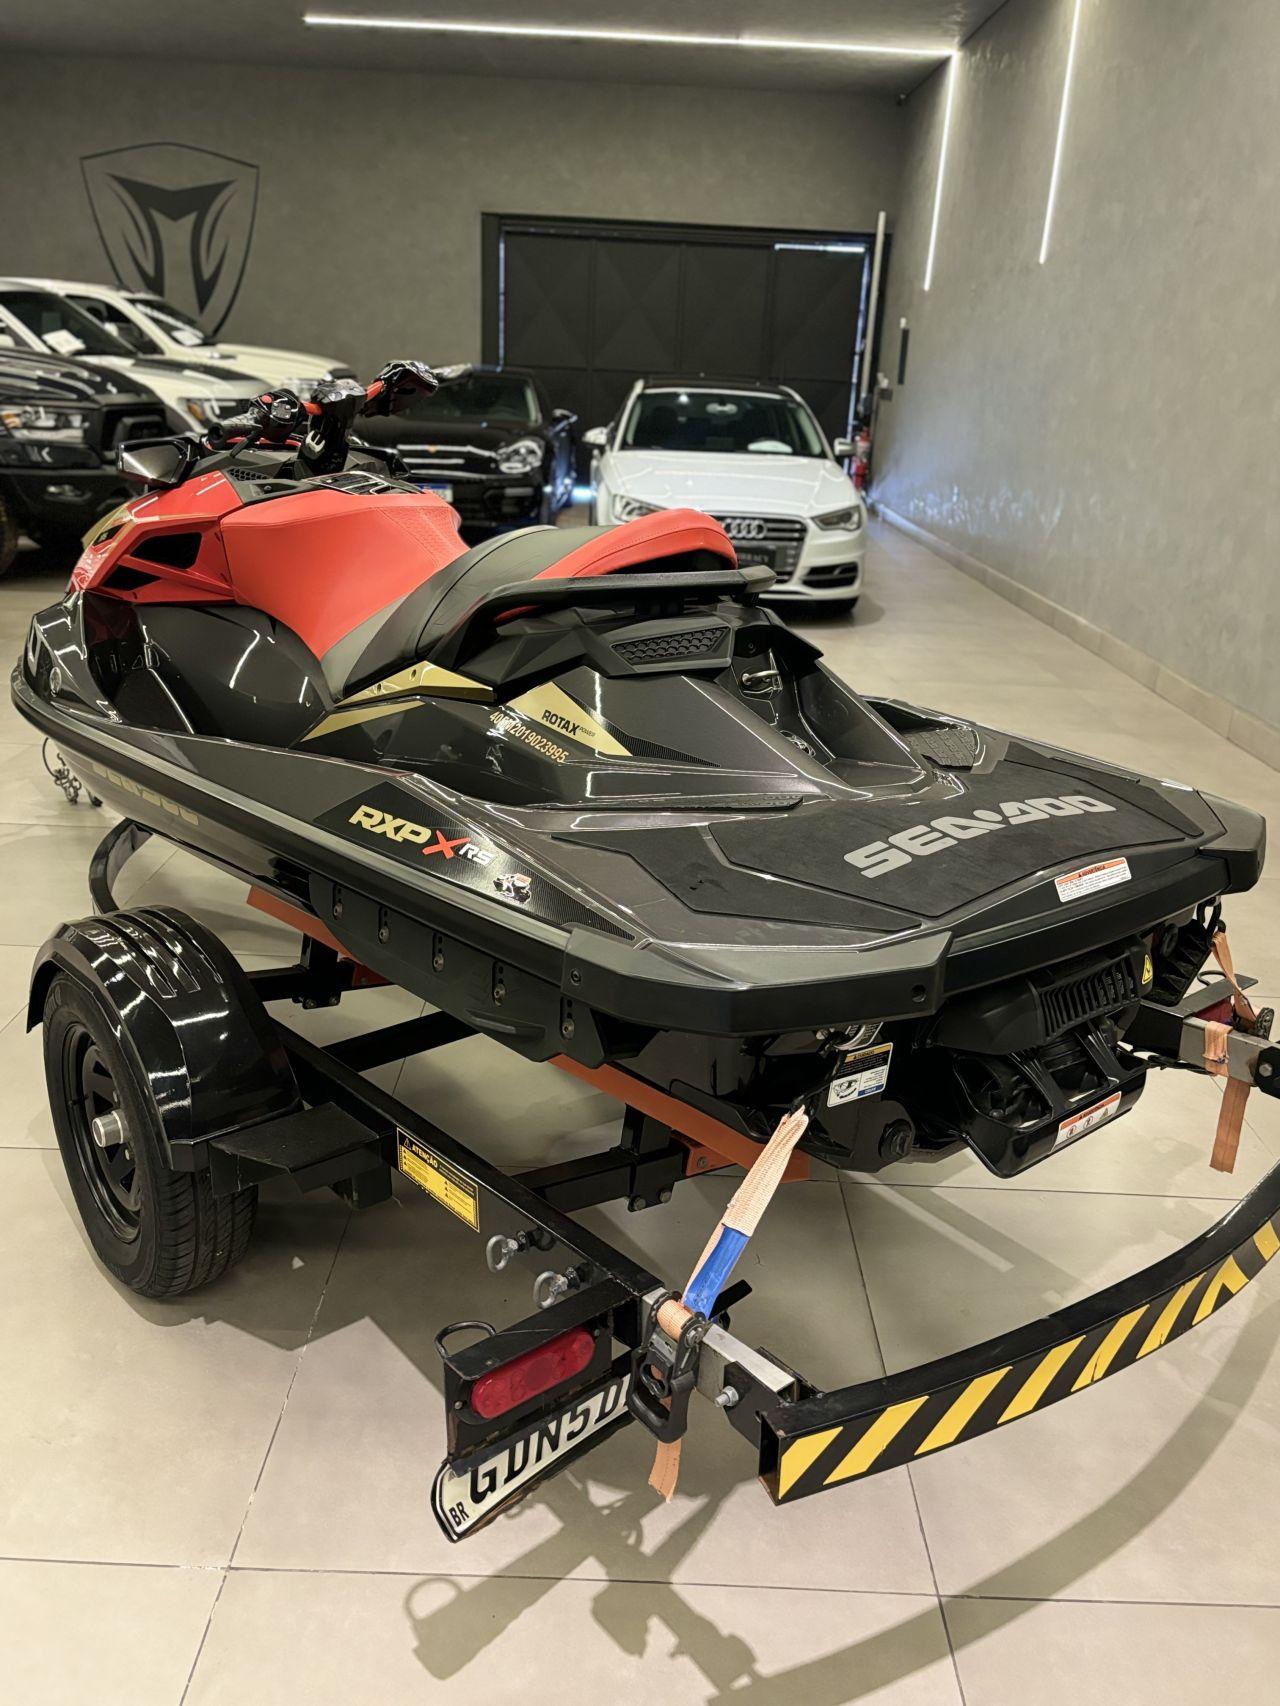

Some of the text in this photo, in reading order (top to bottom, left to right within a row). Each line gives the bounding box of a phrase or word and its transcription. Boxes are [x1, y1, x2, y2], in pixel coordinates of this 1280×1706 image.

[541, 709, 580, 736] ROTAX
[349, 804, 497, 867] RXP X RS
[448, 1501, 470, 1528] BR
